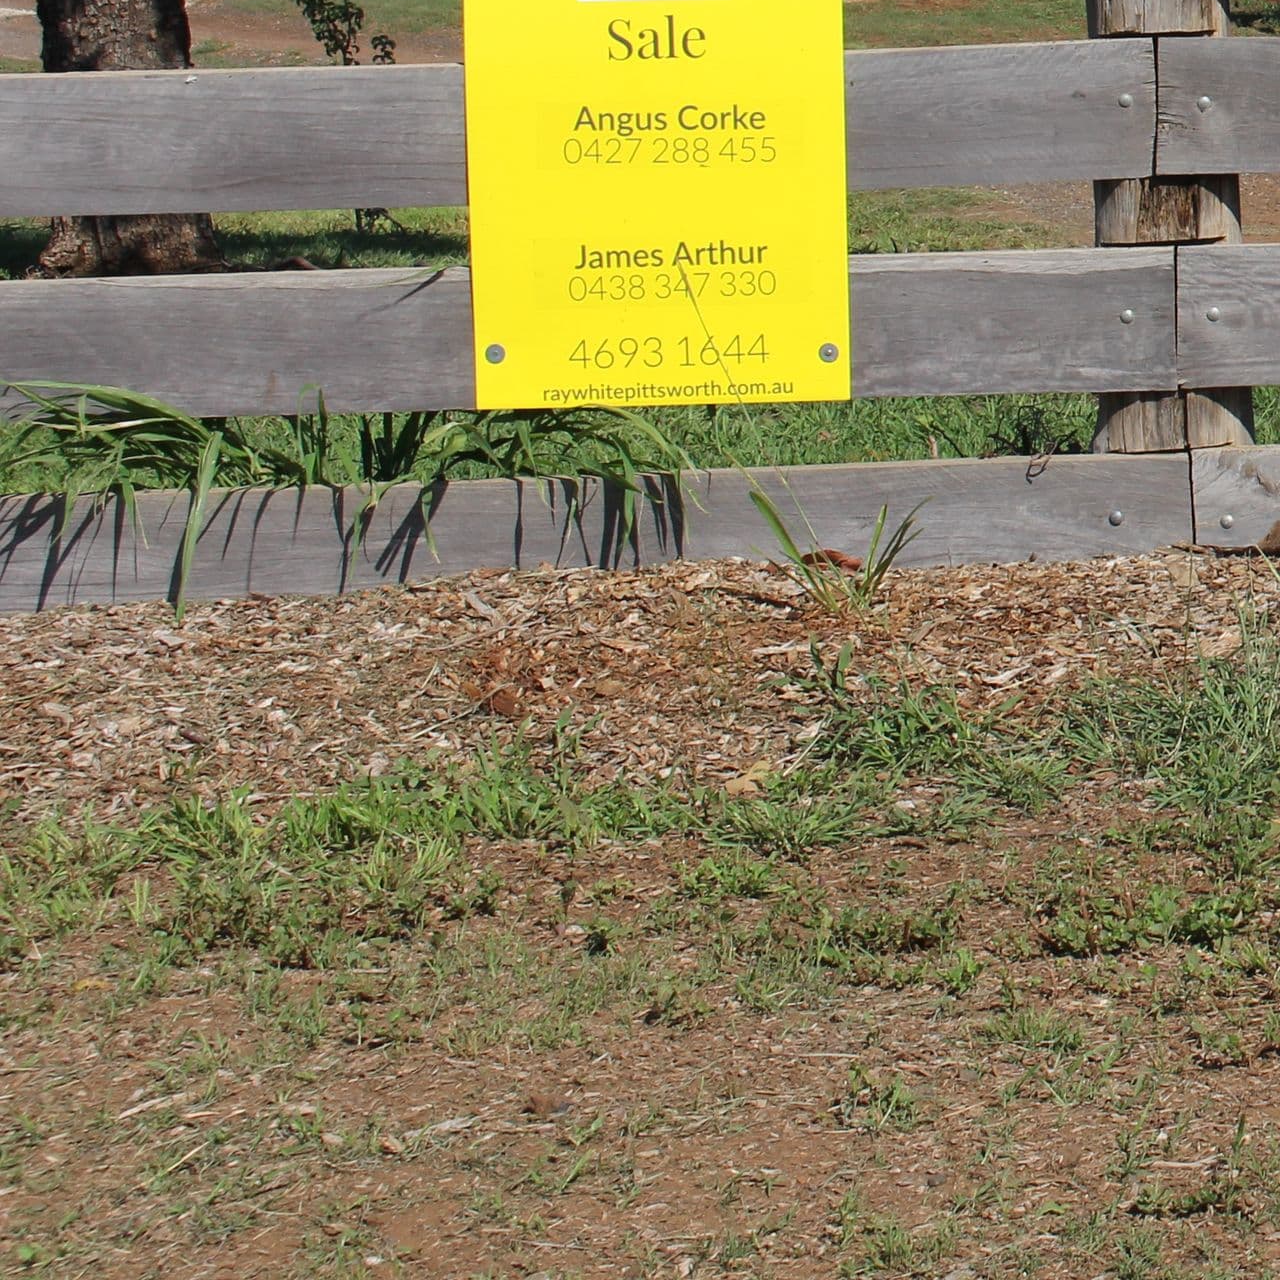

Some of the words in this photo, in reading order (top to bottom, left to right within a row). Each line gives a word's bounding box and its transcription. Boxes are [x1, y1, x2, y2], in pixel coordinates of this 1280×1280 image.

[607, 15, 707, 62] Sale
[573, 105, 668, 137] Angus
[677, 104, 767, 131] Corke
[563, 137, 643, 164] 0427
[652, 137, 711, 164] 288
[718, 136, 777, 163] 455
[574, 243, 664, 270] James
[672, 240, 768, 267] Arthur
[568, 274, 646, 302] 0438
[655, 272, 711, 299] 347
[719, 270, 777, 297] 330
[568, 336, 664, 369] 4693
[678, 334, 771, 367] 1644
[542, 380, 794, 404] raywhitepittsworth.com.au
